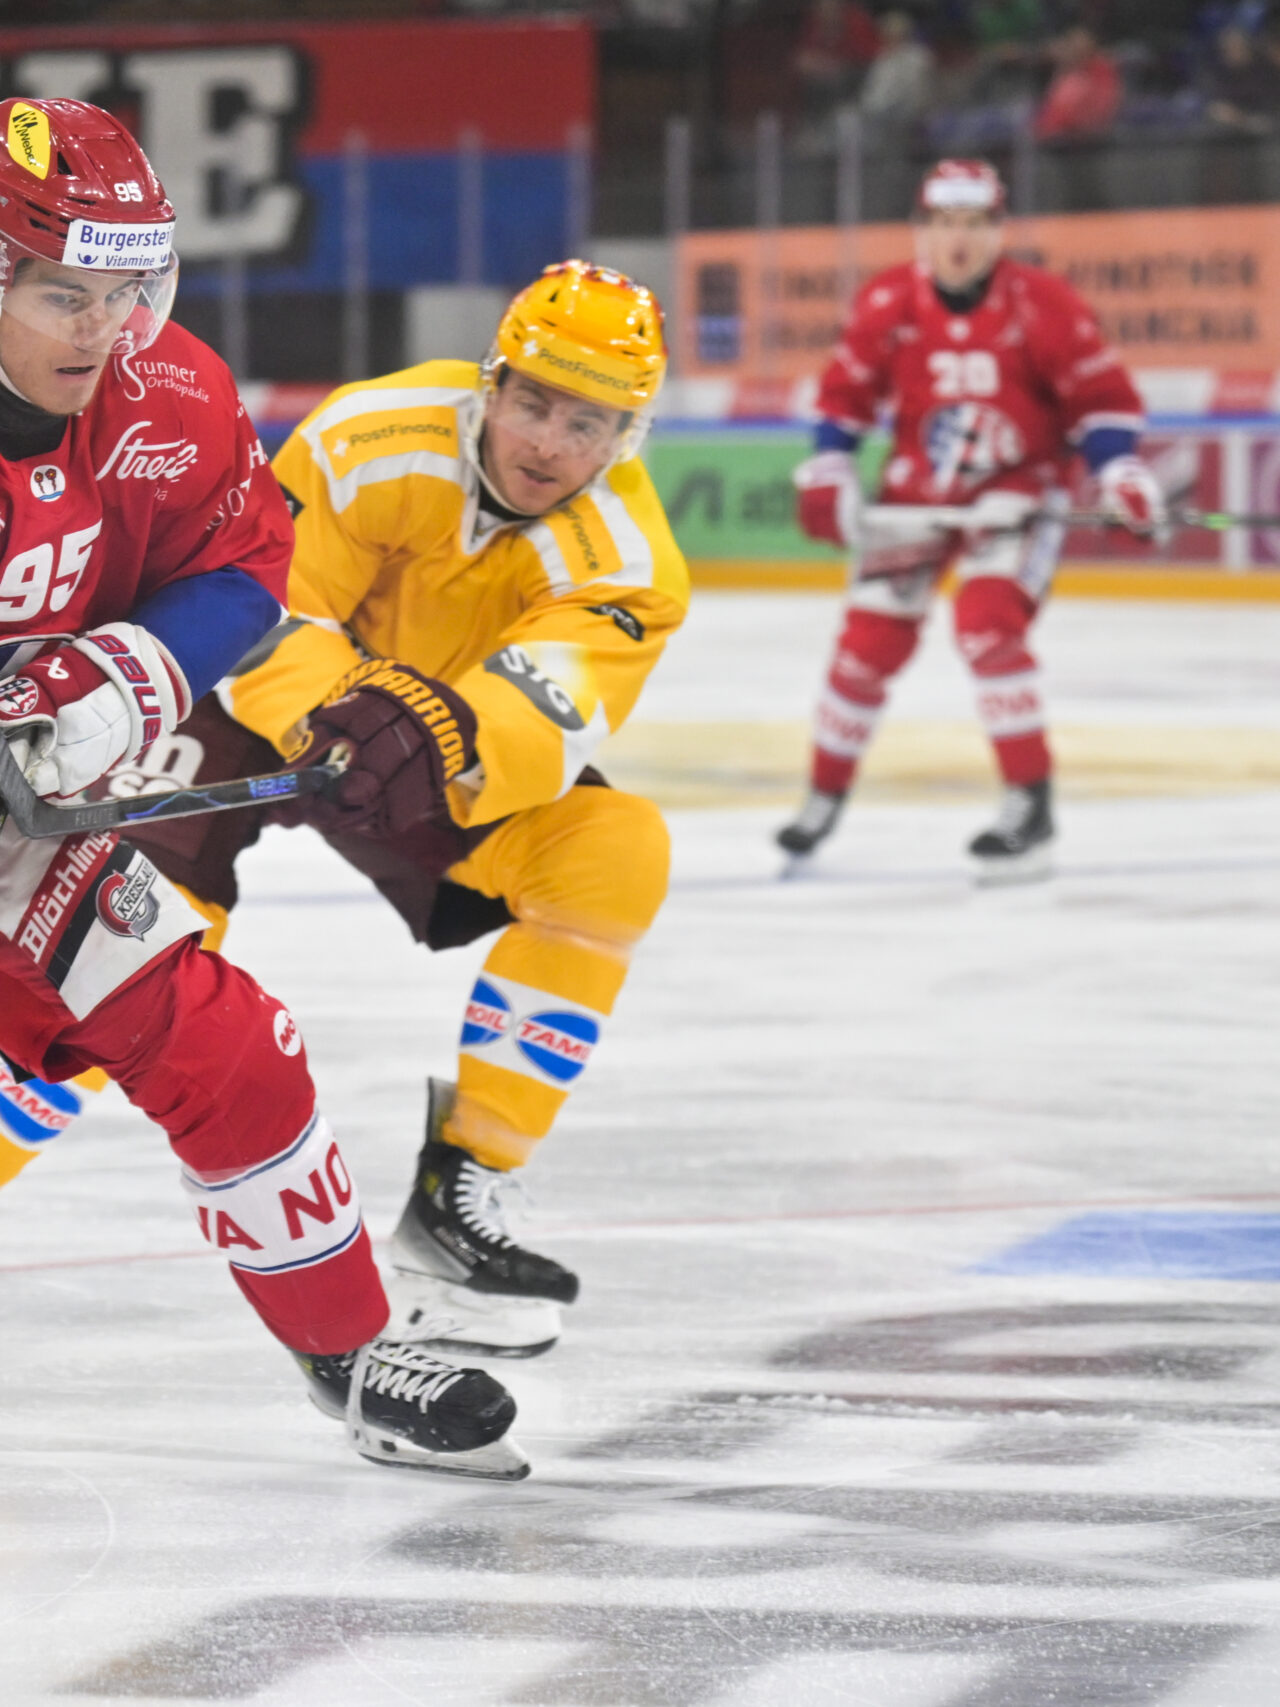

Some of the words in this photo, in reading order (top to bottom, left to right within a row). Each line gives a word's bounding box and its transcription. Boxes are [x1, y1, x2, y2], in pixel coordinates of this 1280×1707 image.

[113, 182, 143, 202] 95
[105, 256, 155, 267] Vitamine
[538, 347, 632, 391] PostFinance
[146, 376, 210, 403] Orthopädie
[350, 424, 452, 447] PostFinance
[357, 668, 465, 781] WARRIOR
